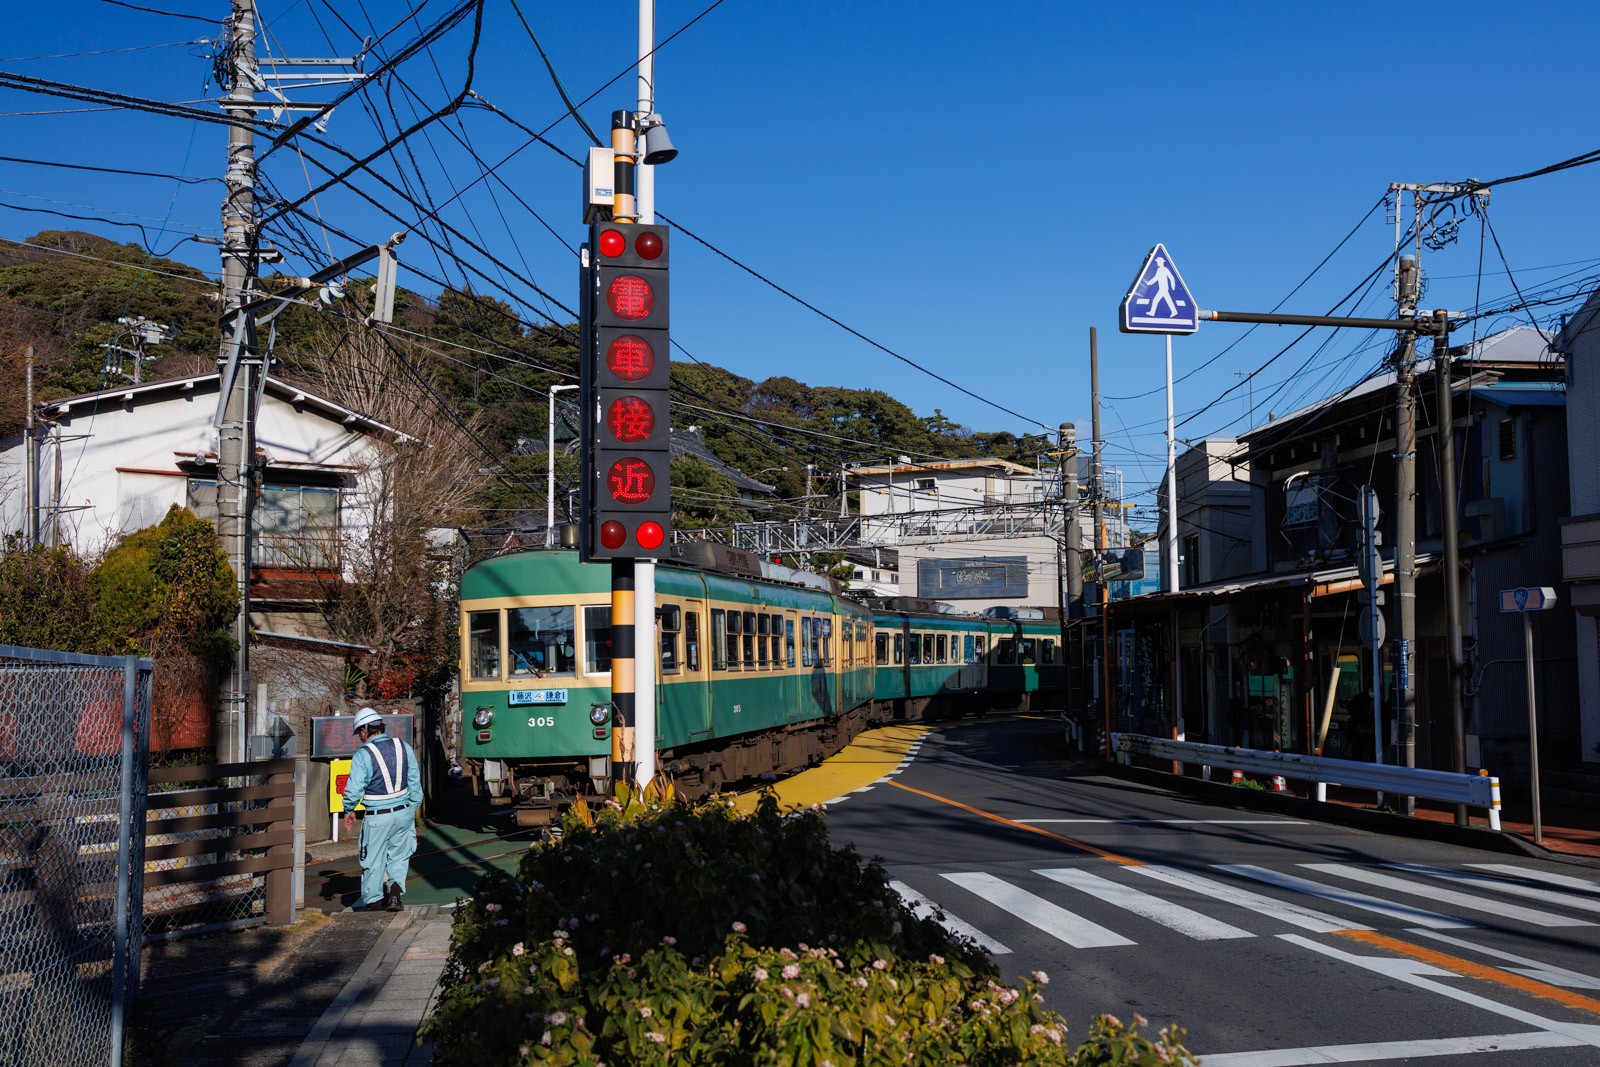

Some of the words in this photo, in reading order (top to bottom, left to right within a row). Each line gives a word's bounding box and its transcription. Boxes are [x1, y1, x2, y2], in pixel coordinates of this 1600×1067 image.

[611, 277, 649, 500] 電車接近
[516, 691, 533, 700] 藤沢
[545, 691, 562, 700] 鎌倉
[527, 716, 555, 727] 305
